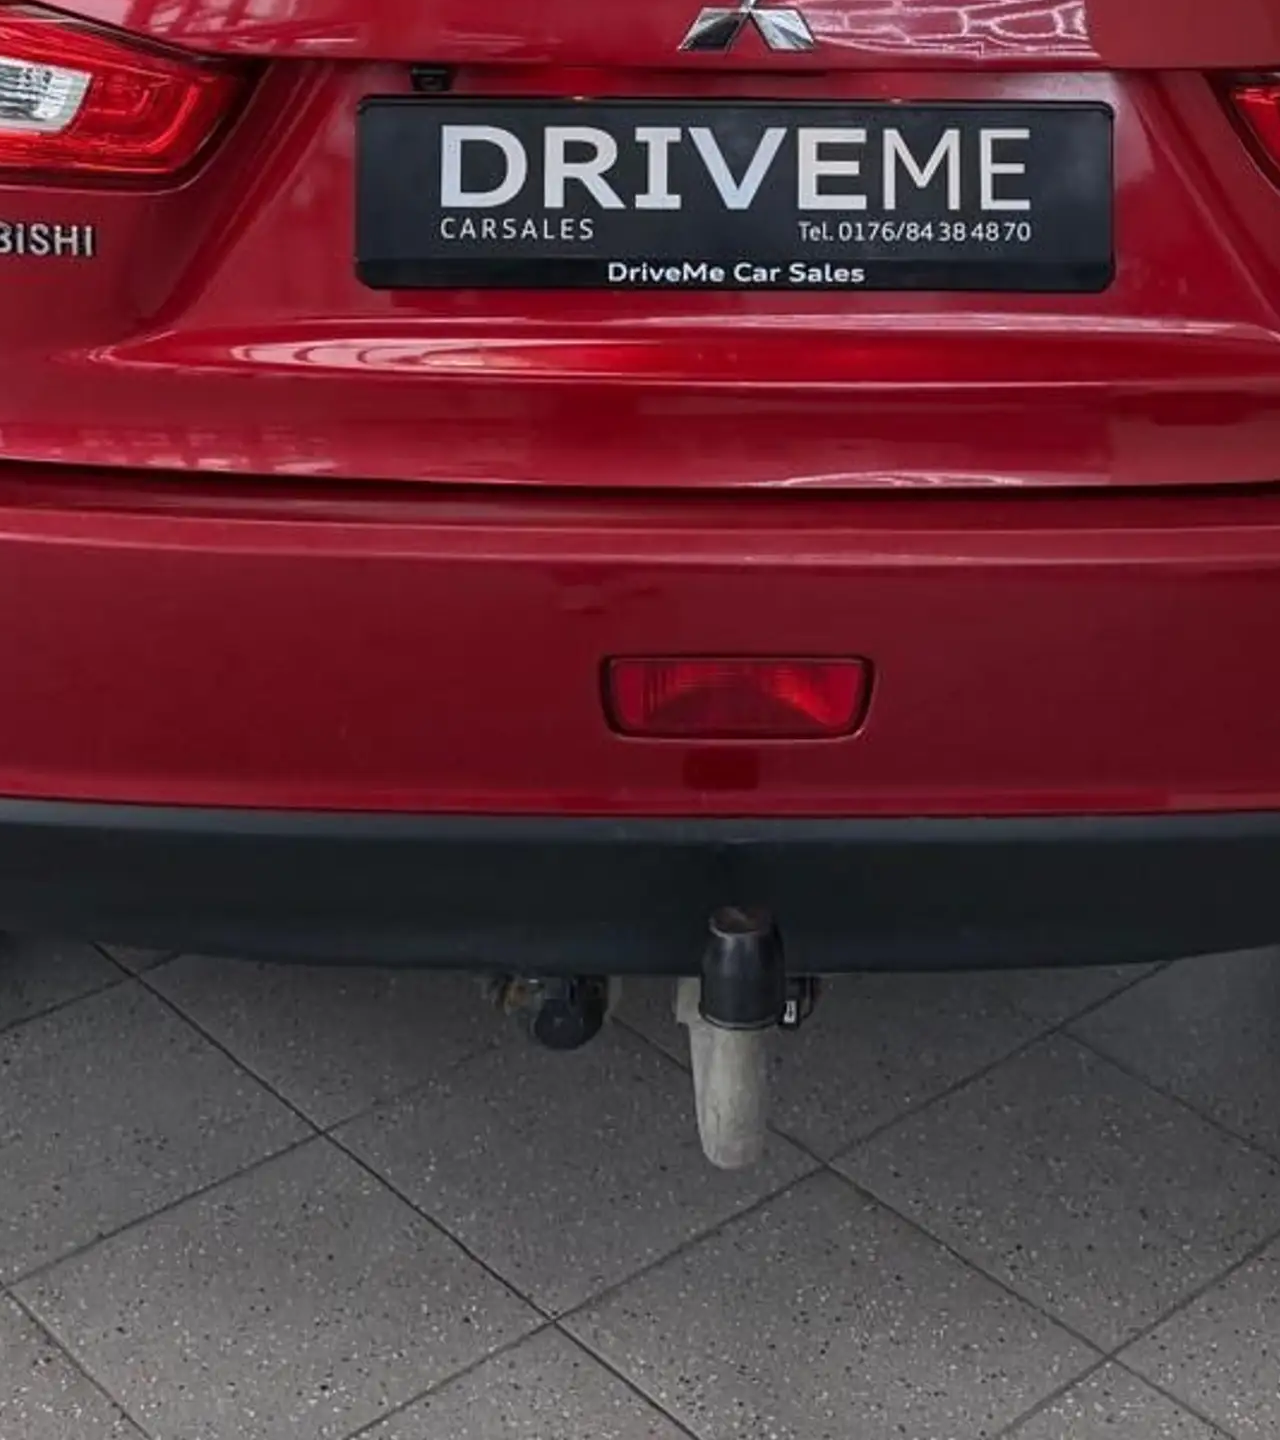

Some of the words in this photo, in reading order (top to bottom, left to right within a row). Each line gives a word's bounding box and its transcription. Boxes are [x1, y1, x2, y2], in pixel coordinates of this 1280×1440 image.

[440, 123, 1031, 211] DRIVEME
[440, 217, 595, 241] CARSALES
[607, 262, 725, 284] DriveMe
[733, 263, 781, 284] Car
[789, 263, 866, 284] Sales
